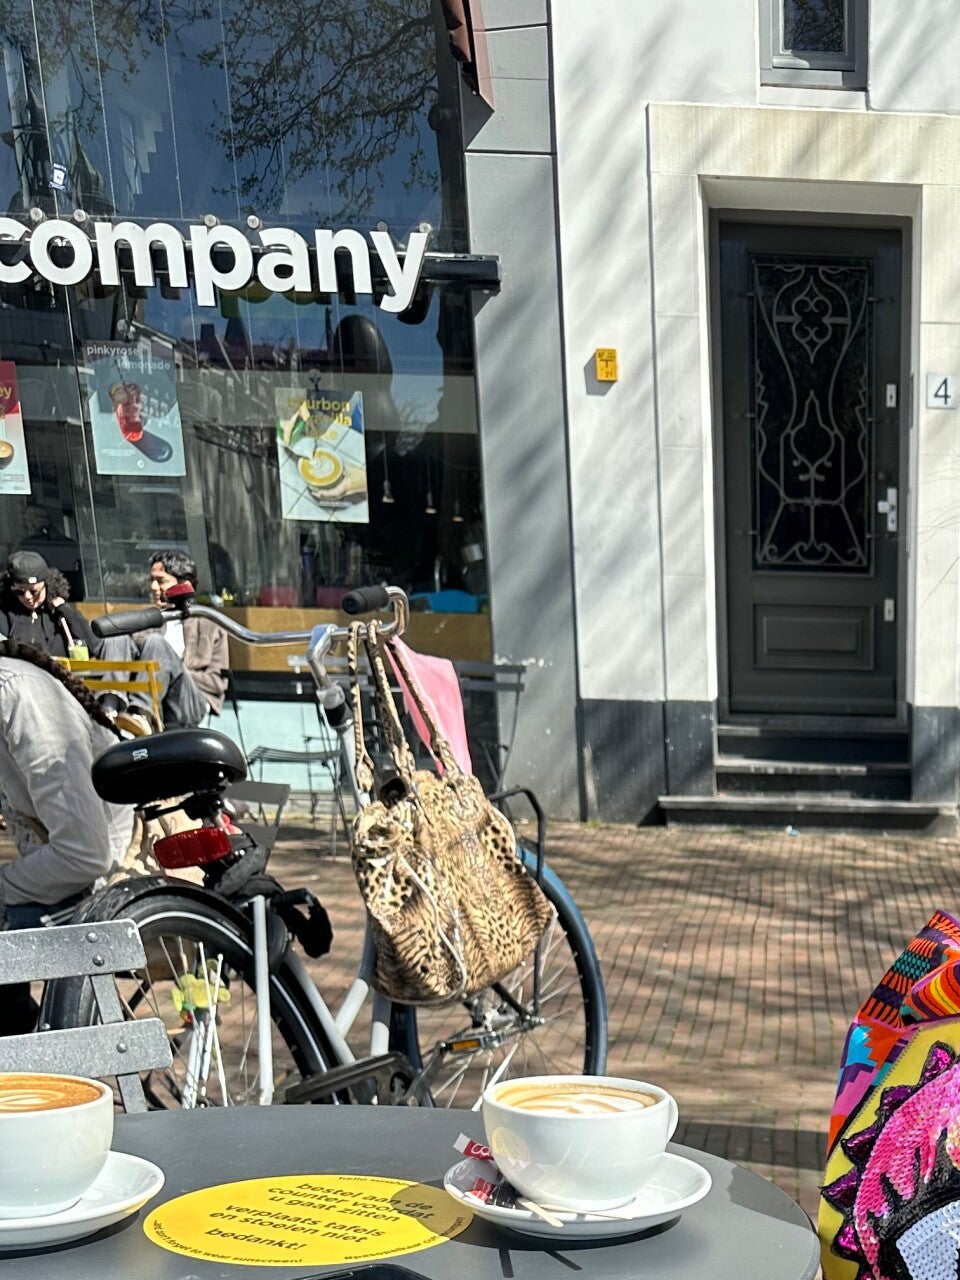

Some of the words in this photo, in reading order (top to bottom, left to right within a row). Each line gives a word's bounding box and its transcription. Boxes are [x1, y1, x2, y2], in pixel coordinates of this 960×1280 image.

[934, 378, 951, 405] 4
[267, 1187, 349, 1204] counter
[352, 1201, 434, 1219] voordat
[296, 1183, 363, 1198] bestel
[363, 1194, 401, 1204] aan
[405, 1202, 434, 1210] de
[225, 1205, 322, 1226] verplaats
[324, 1222, 386, 1237] tafels
[285, 1199, 337, 1211] gaat
[337, 1207, 401, 1222] zitten
[205, 1228, 307, 1250] bedankt!
[209, 1211, 237, 1220] en
[239, 1217, 320, 1235] stoelen
[321, 1231, 367, 1243] niet
